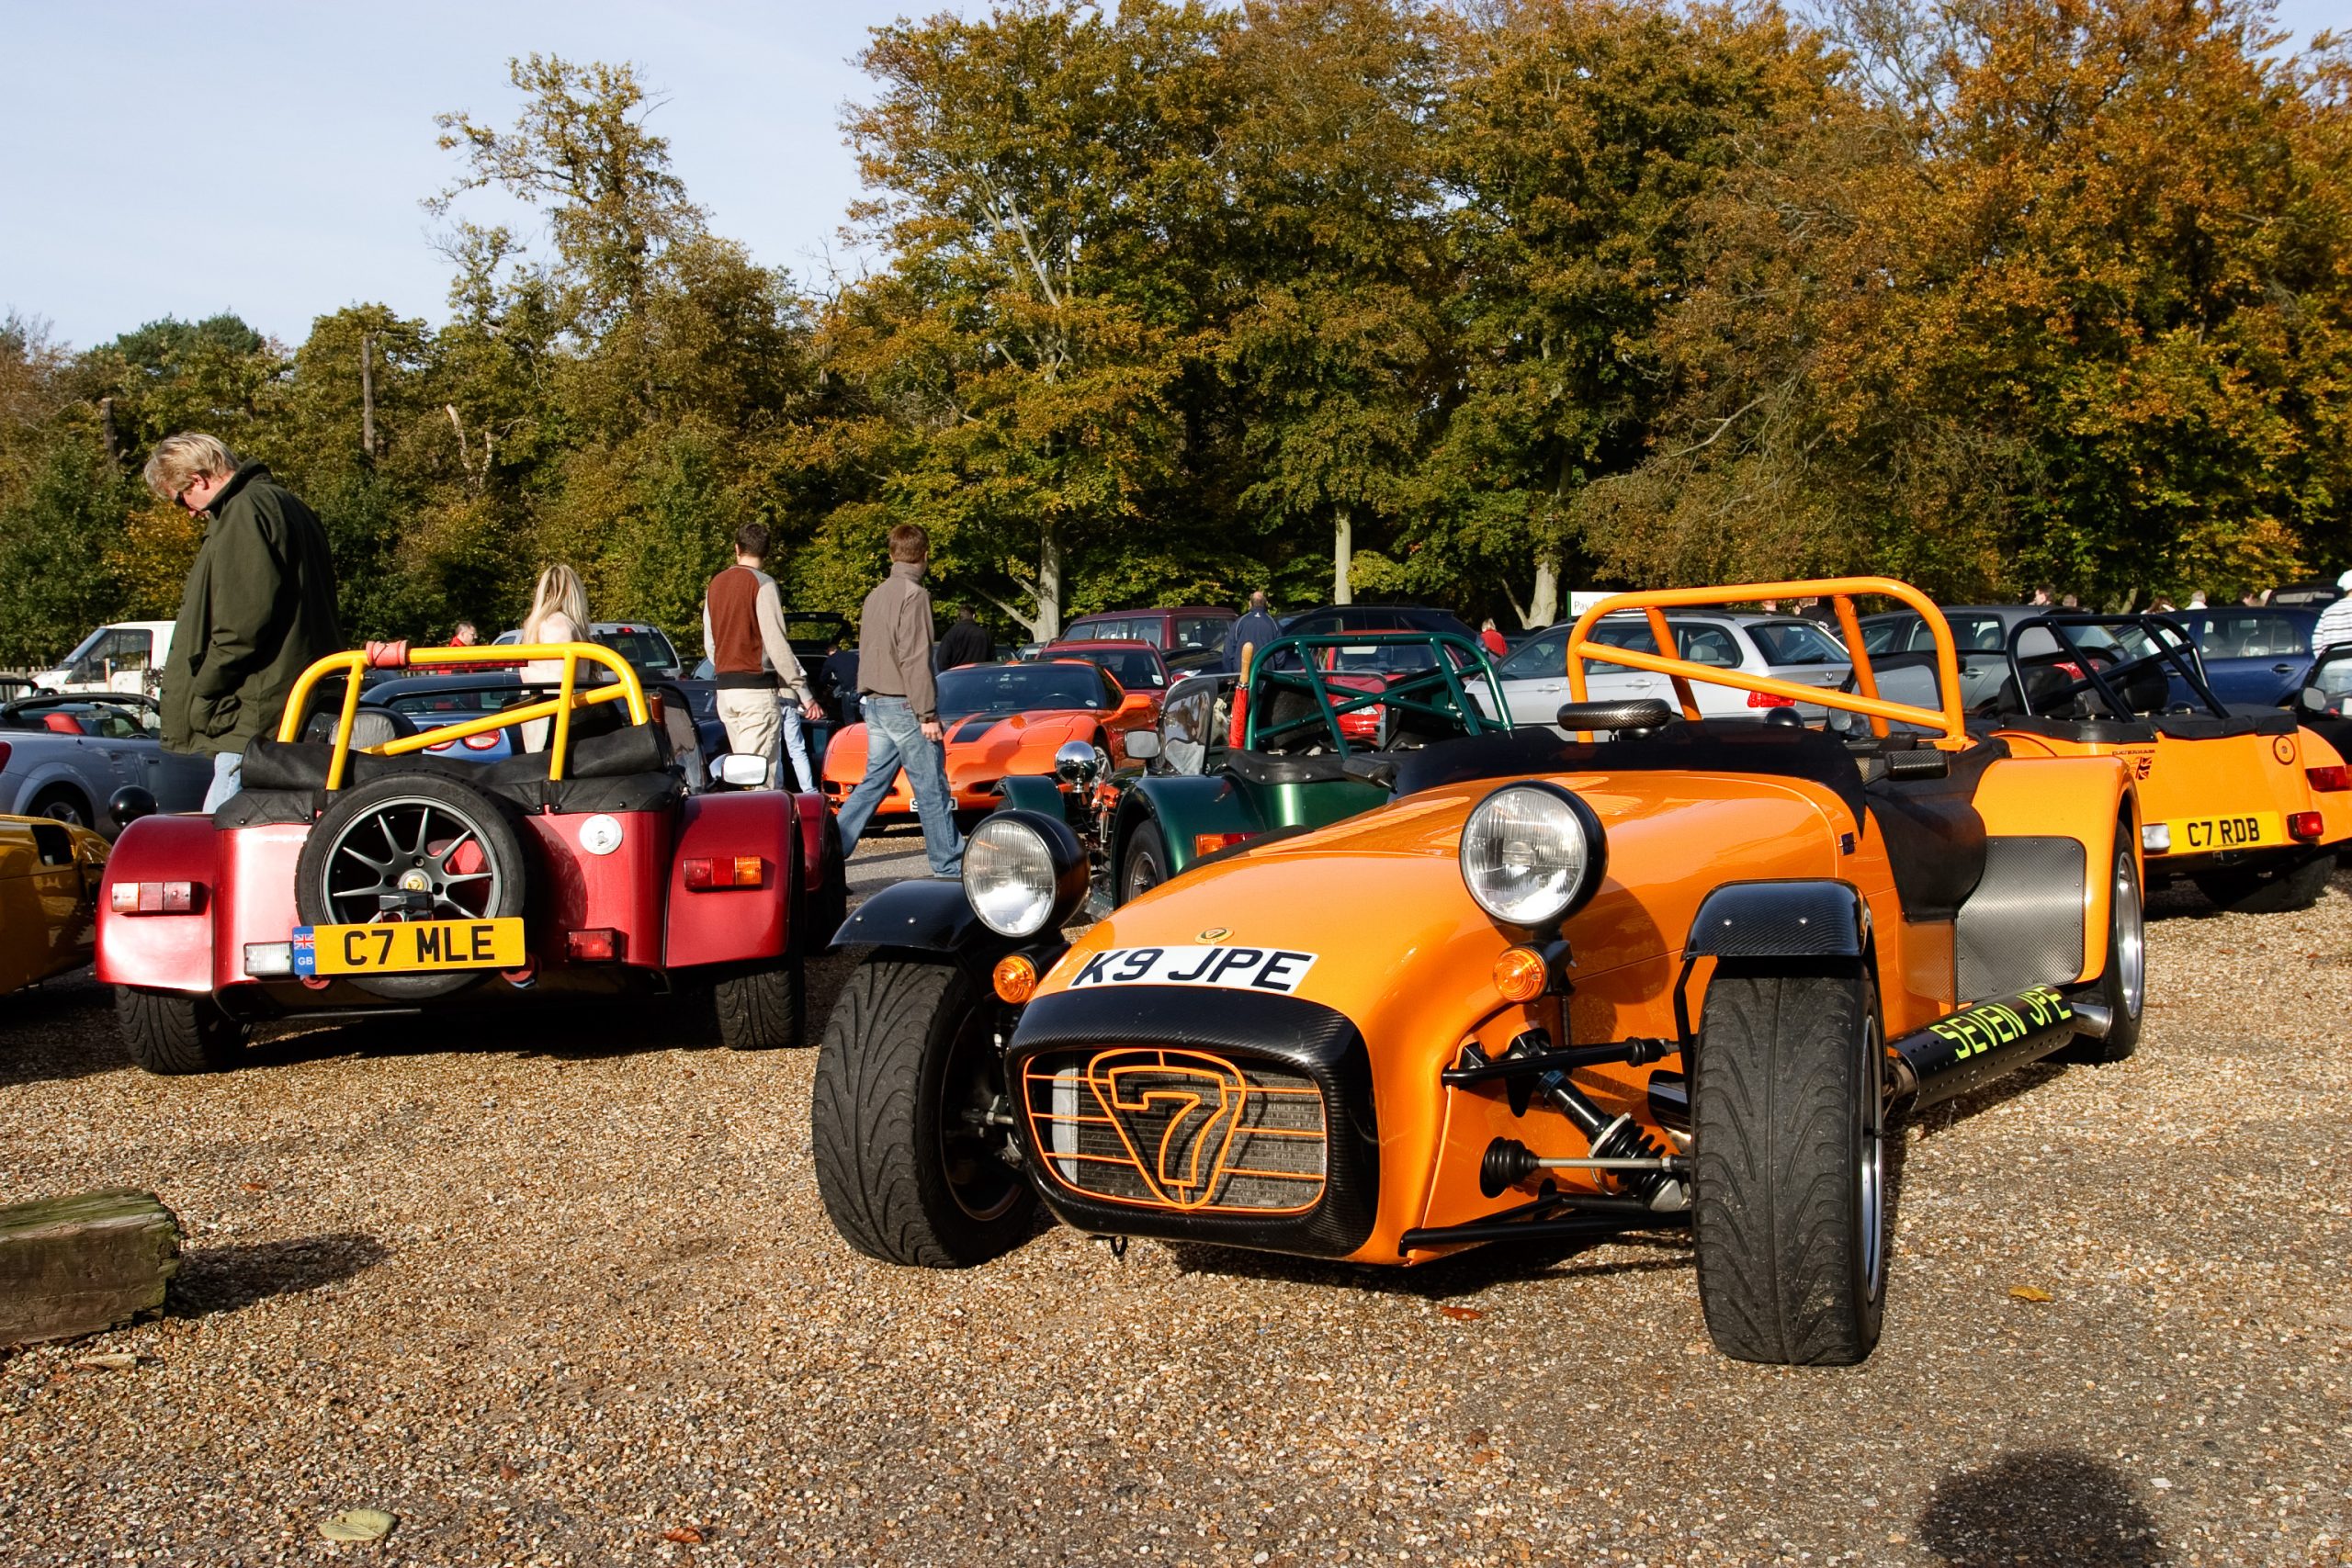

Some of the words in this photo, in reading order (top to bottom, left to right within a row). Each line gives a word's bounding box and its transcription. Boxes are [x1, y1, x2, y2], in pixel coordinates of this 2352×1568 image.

[2187, 820, 2212, 847] C7
[2219, 818, 2260, 843] RDB
[298, 956, 313, 965] GB
[344, 929, 394, 966] C7
[416, 925, 495, 963] MLE
[1071, 949, 1164, 987] K9
[1167, 948, 1313, 992] JPE
[1928, 1003, 2028, 1060] SEVEN
[2016, 985, 2072, 1027] JPE
[1109, 1066, 1228, 1187] 7
